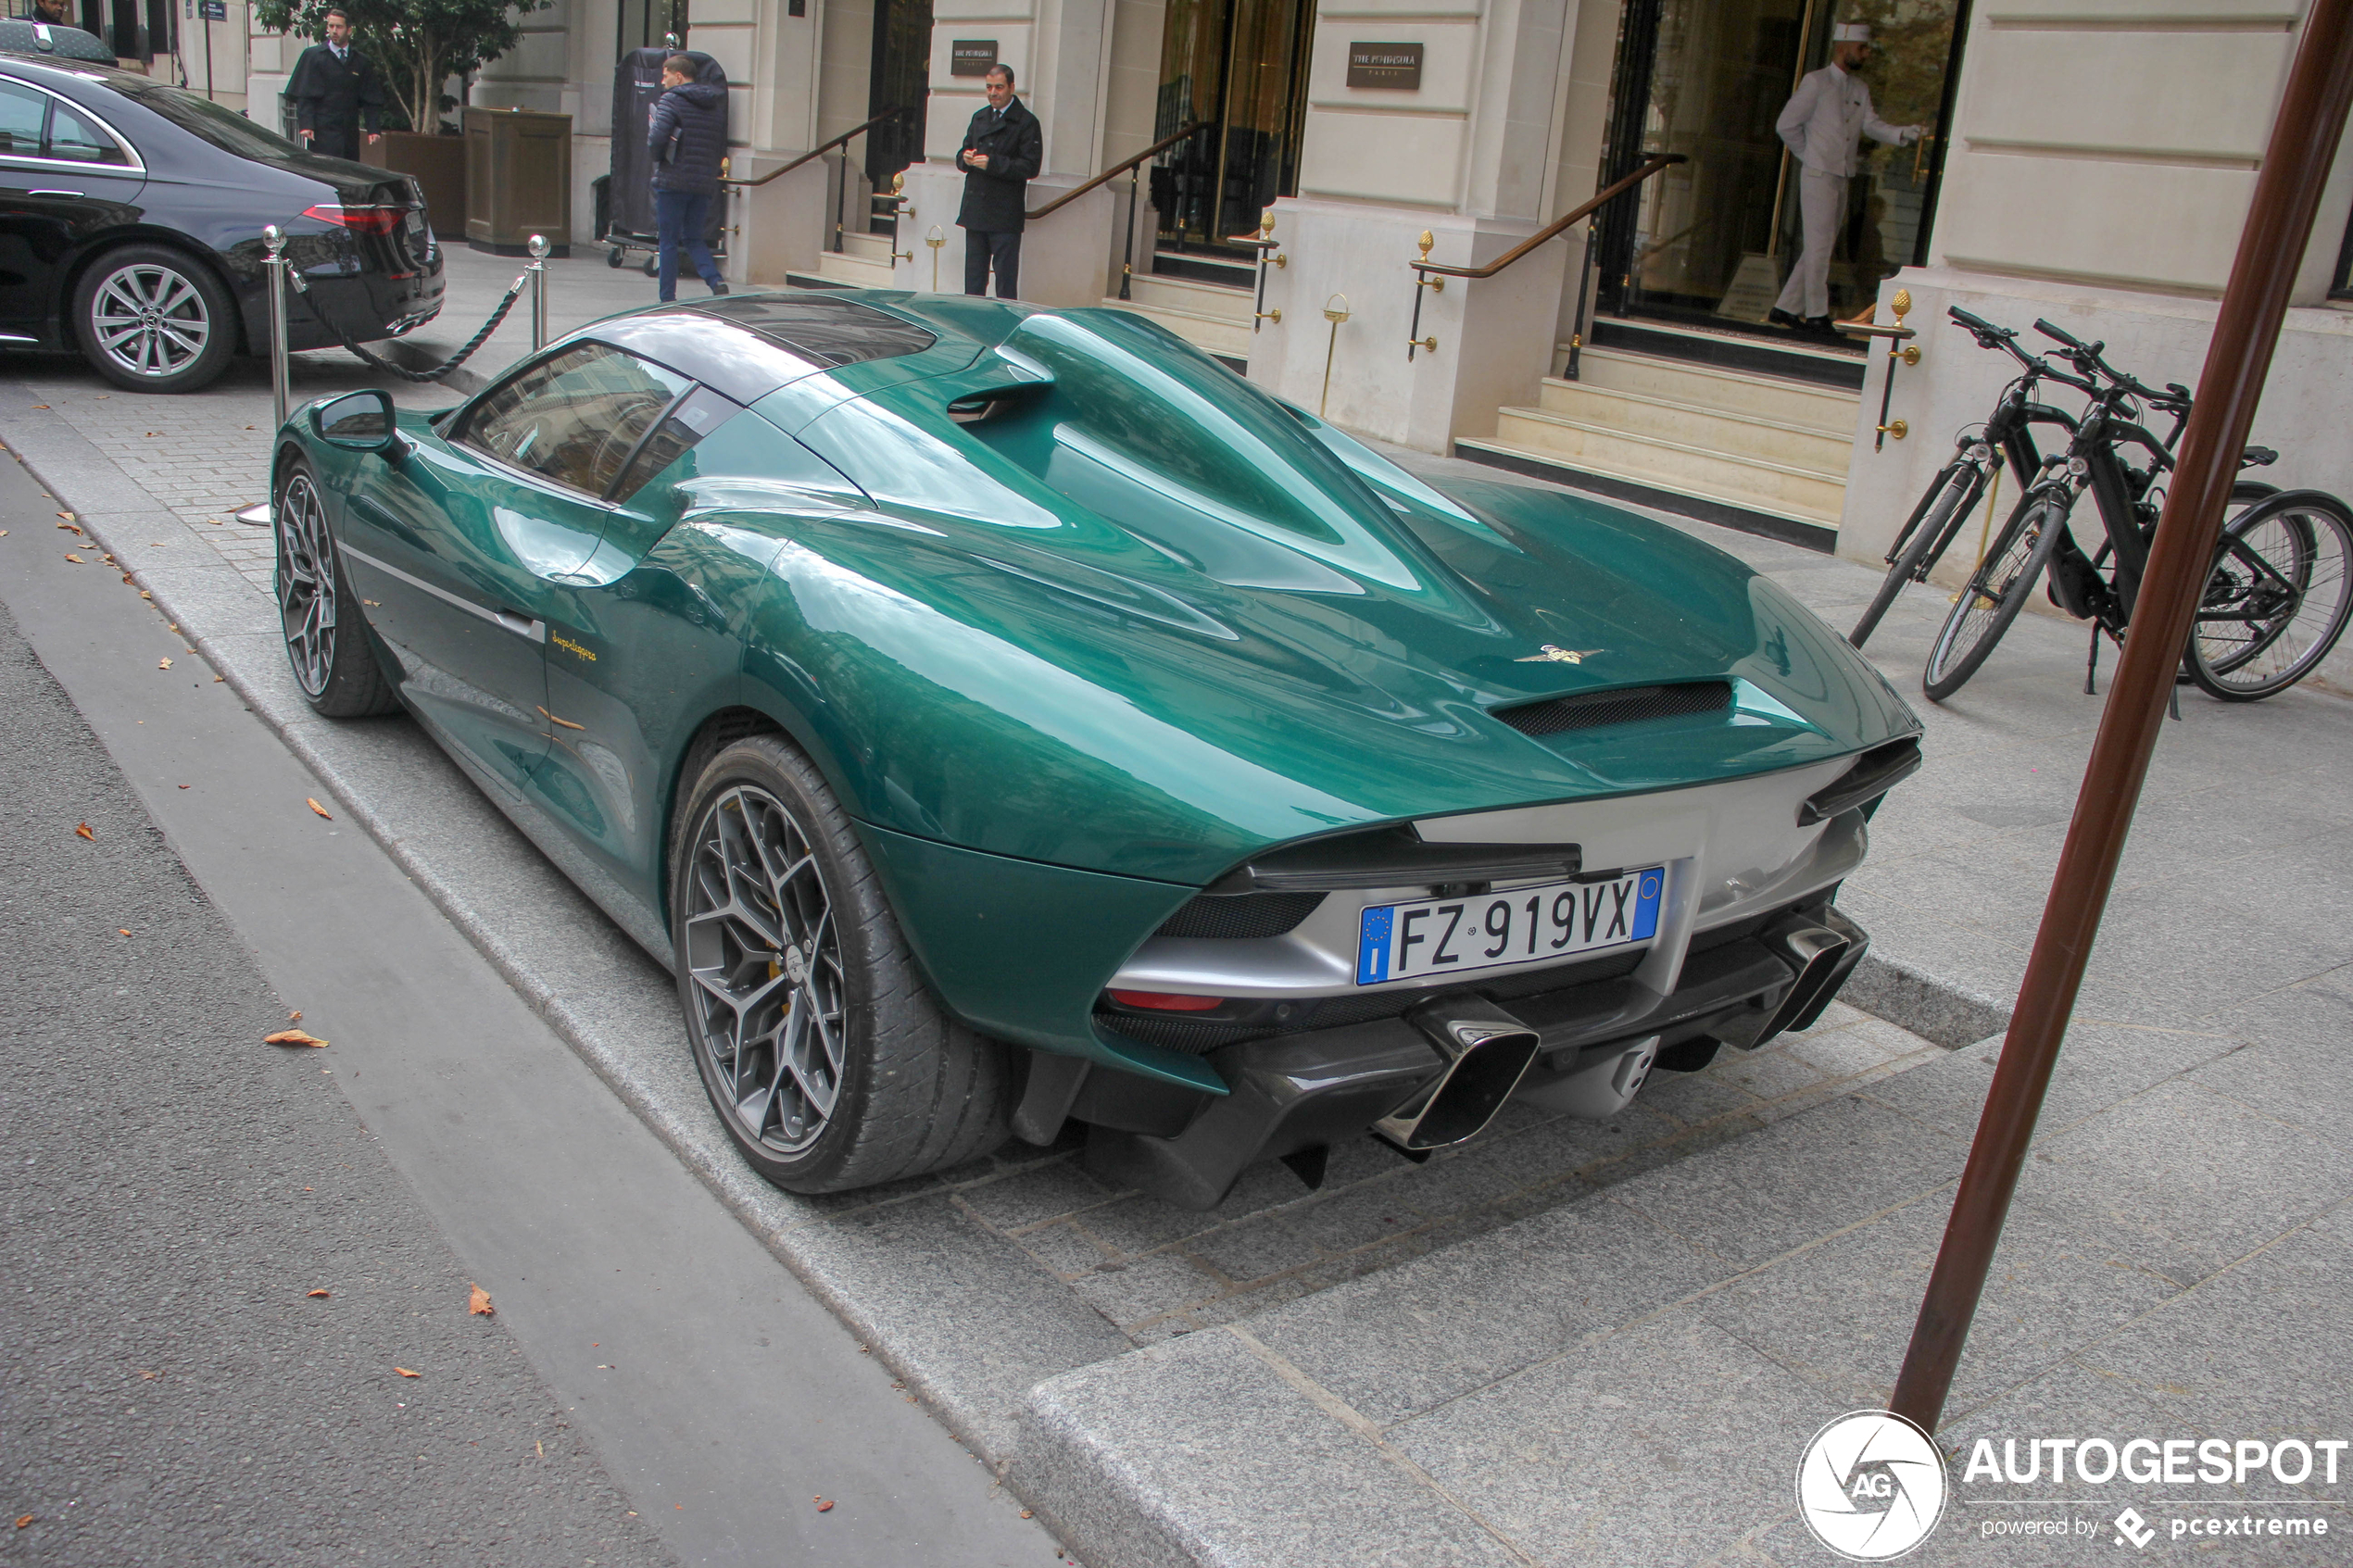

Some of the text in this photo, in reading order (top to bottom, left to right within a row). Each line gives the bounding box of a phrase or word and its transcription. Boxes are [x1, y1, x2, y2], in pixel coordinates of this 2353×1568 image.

[1353, 55, 1416, 65] THE PENINSULA
[1398, 880, 1633, 972] FZ 919VX
